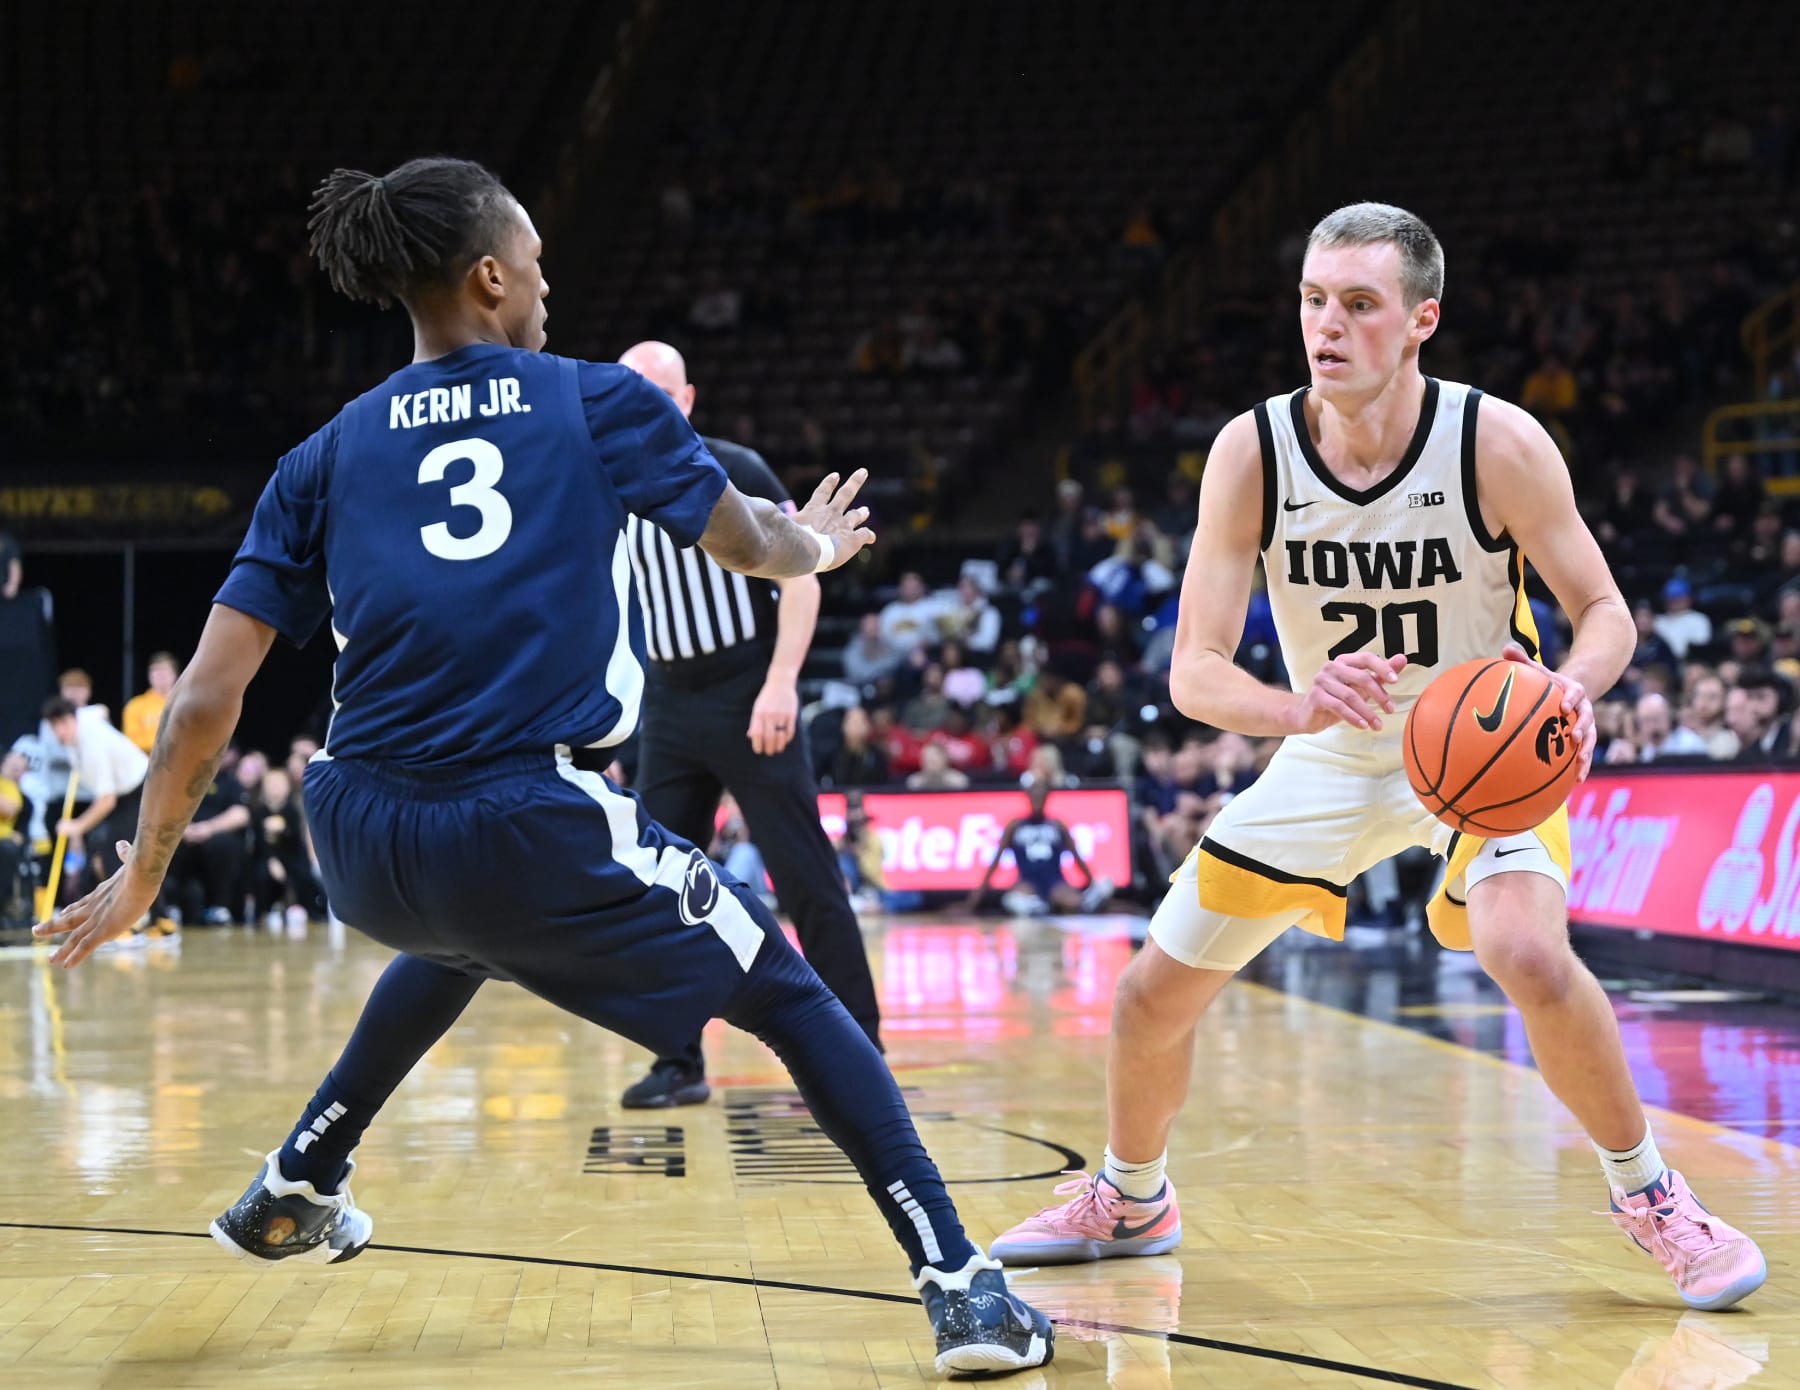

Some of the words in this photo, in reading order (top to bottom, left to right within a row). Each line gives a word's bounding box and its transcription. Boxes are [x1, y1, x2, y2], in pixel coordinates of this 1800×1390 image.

[389, 384, 472, 430] KERN
[479, 377, 532, 417] JR.
[417, 437, 513, 561] 3
[1285, 537, 1462, 589] IOWA
[1320, 599, 1439, 668] 20
